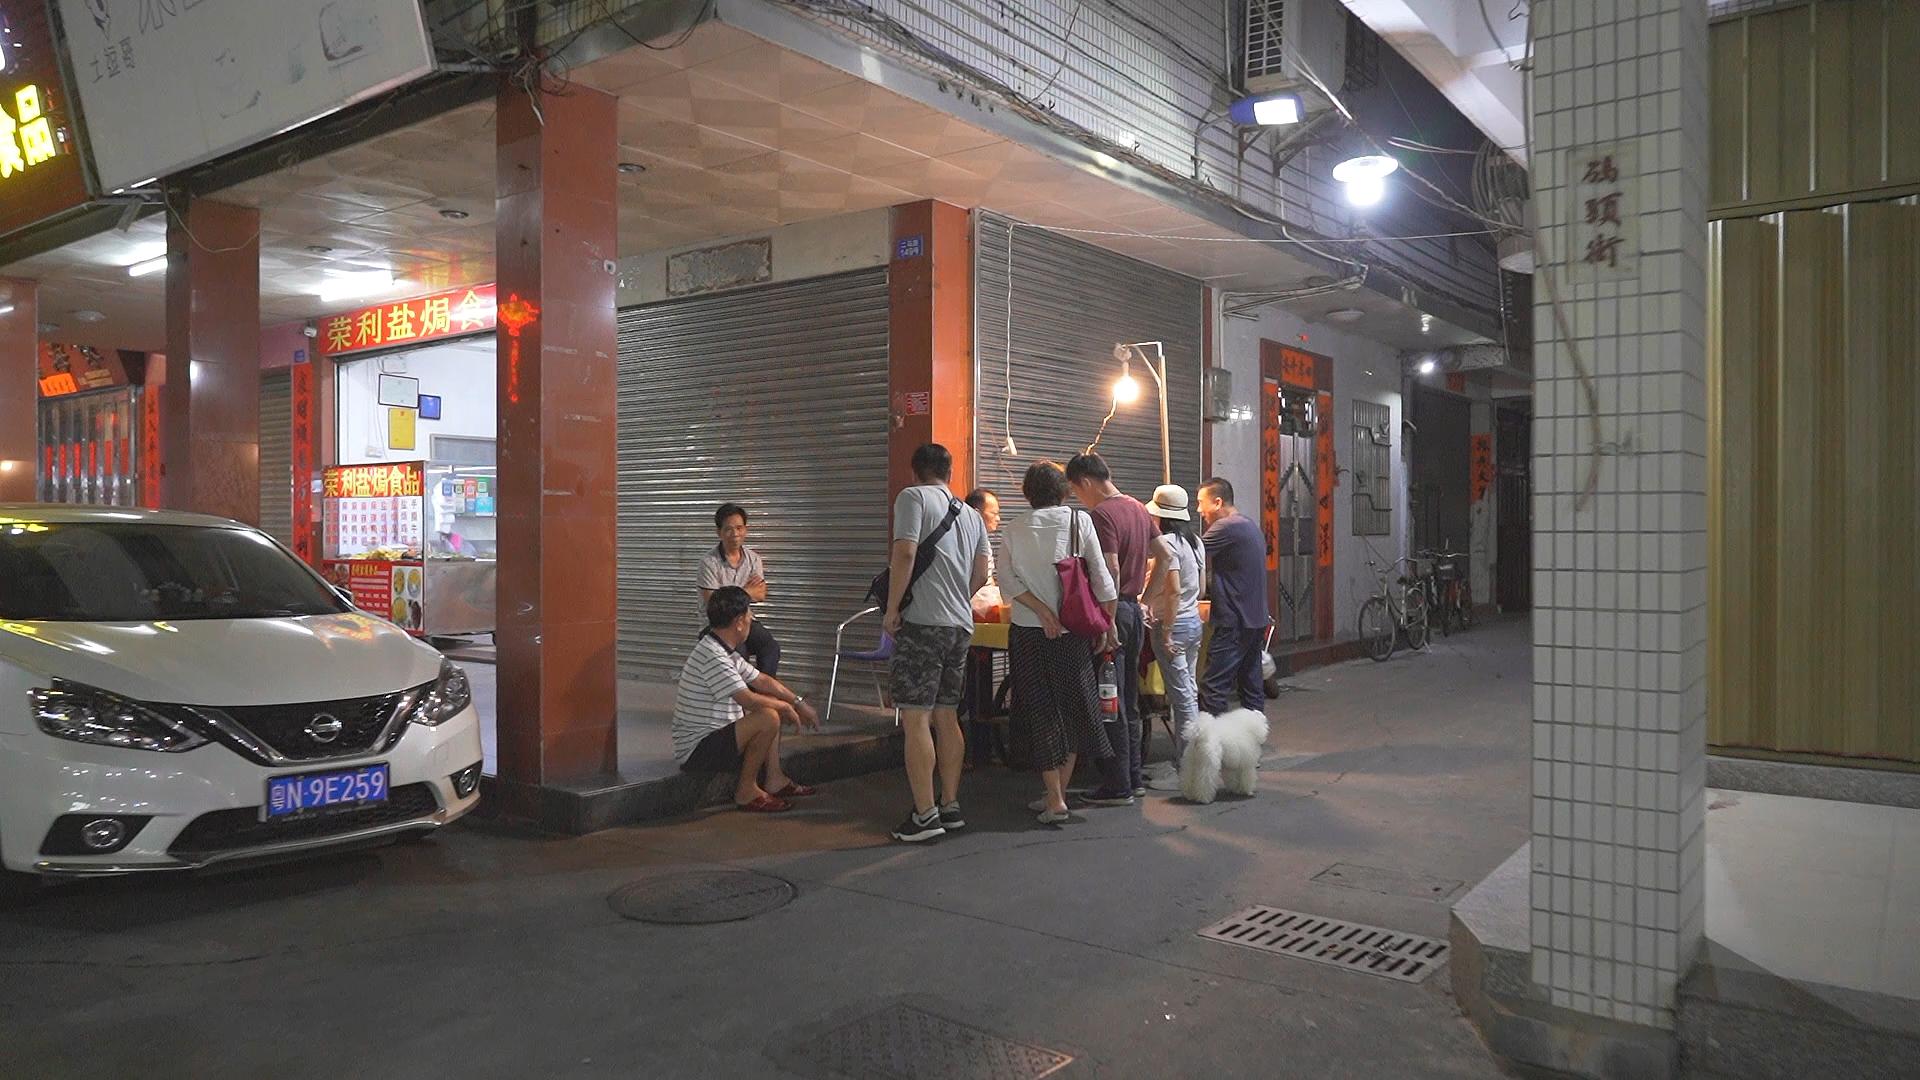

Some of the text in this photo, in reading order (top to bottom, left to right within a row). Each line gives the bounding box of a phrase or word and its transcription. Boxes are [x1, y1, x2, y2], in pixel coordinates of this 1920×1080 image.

[324, 465, 421, 497] 荣利盐焗食品
